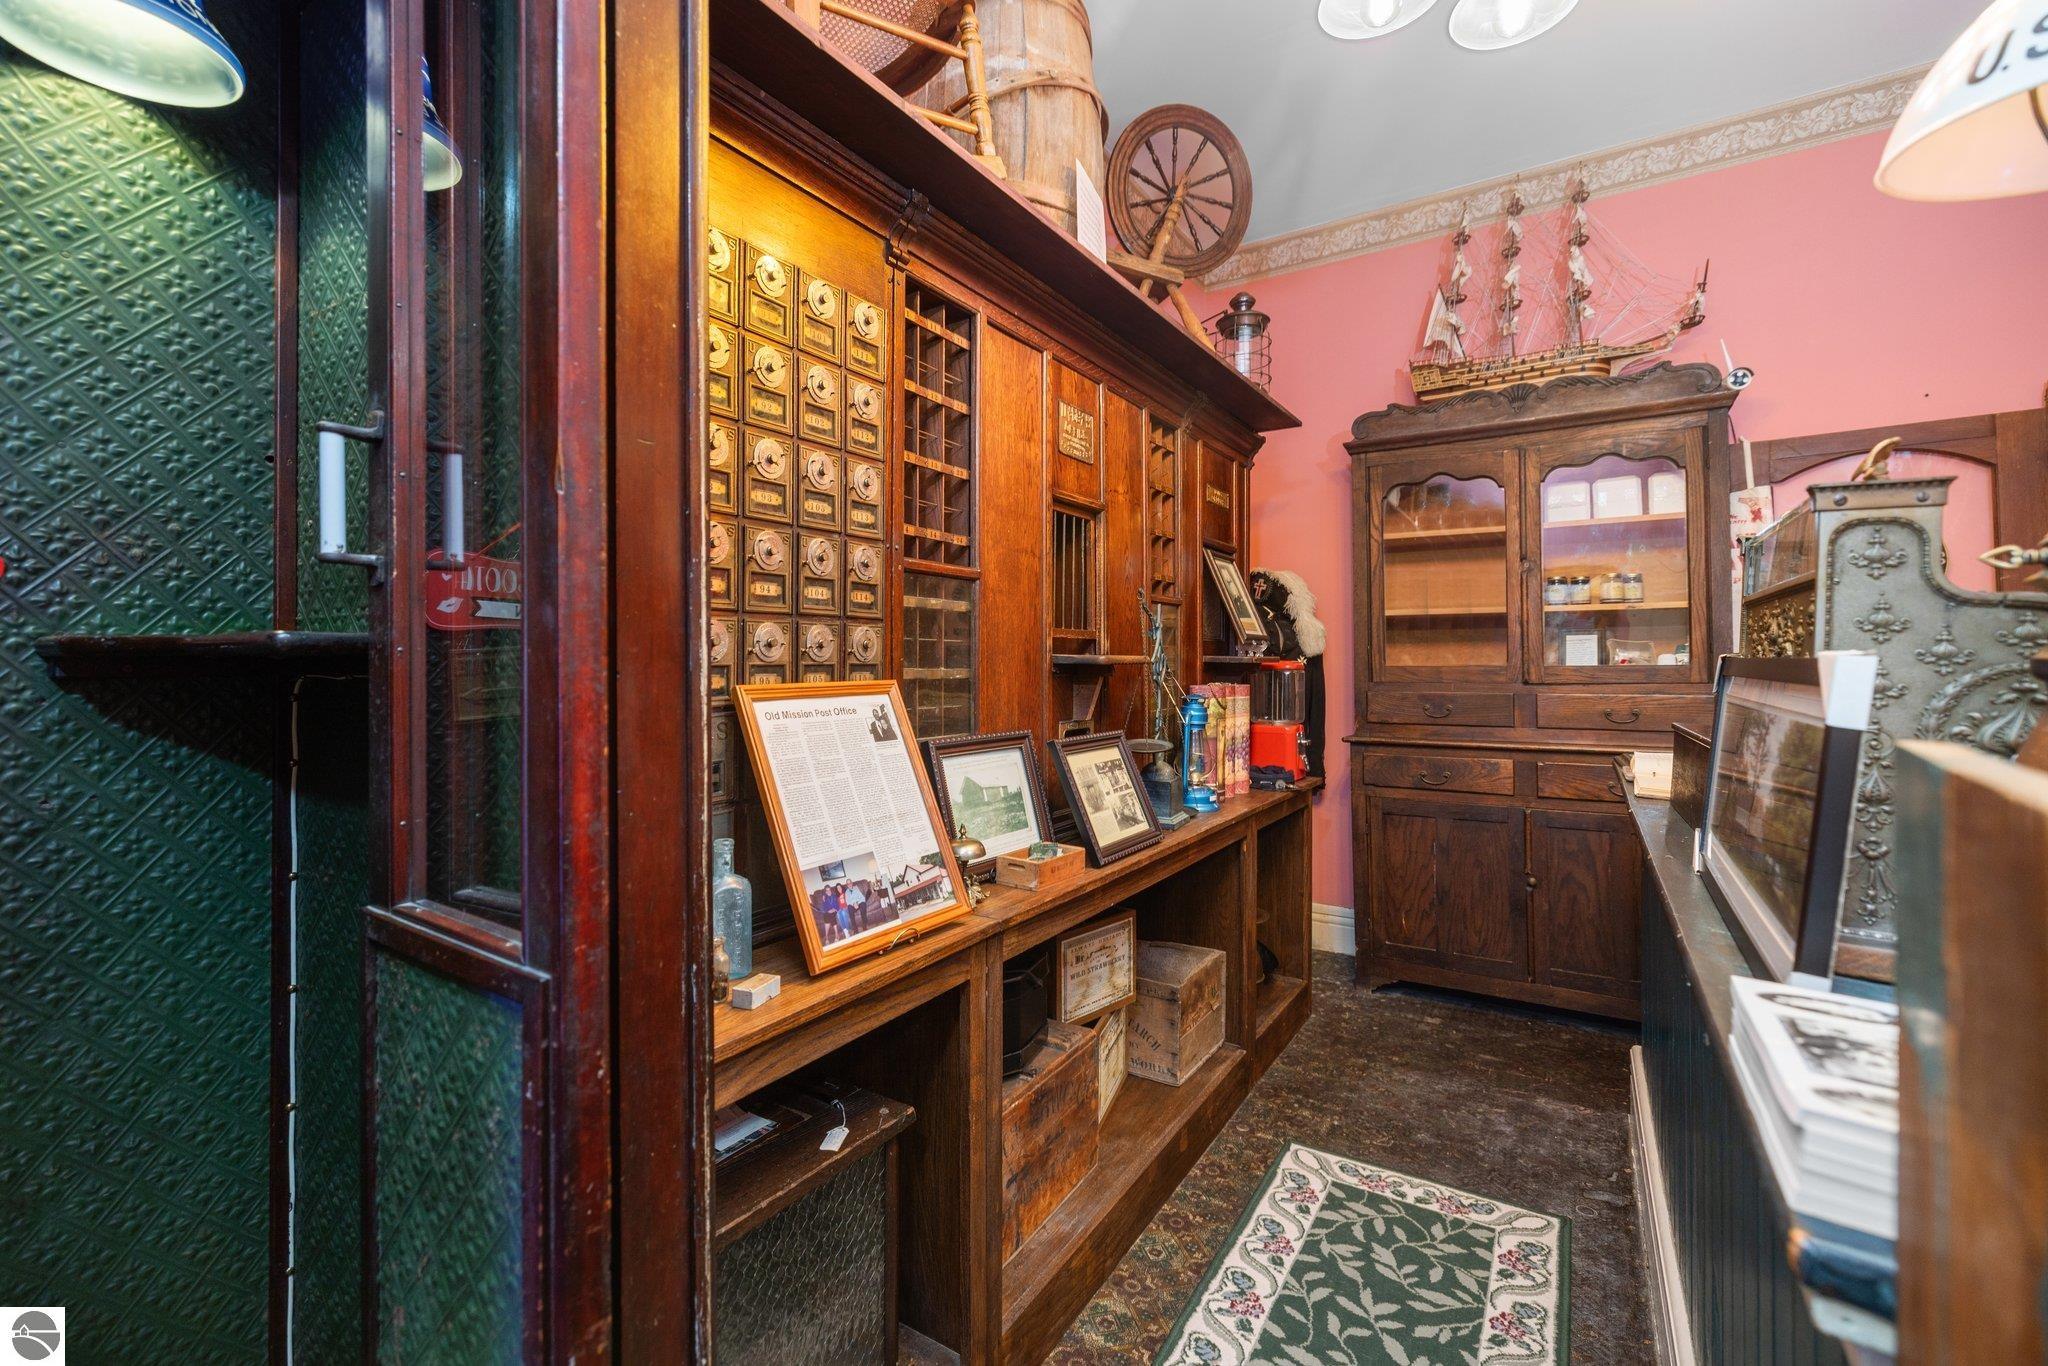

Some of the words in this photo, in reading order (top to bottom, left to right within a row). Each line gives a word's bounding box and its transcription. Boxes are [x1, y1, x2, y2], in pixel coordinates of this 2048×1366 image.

[760, 401, 773, 412] 92
[810, 416, 826, 428] 102
[760, 492, 773, 503] 93
[810, 502, 827, 513] 103
[855, 512, 870, 522] 113
[759, 584, 771, 595] 94
[808, 588, 825, 598] 104
[853, 591, 869, 601] 114
[758, 676, 771, 686] 95
[806, 674, 824, 684] 105
[764, 711, 781, 721] Old
[781, 708, 814, 720] Mission
[814, 707, 833, 718] Post
[833, 706, 858, 716] Office
[1070, 969, 1086, 981] WILD
